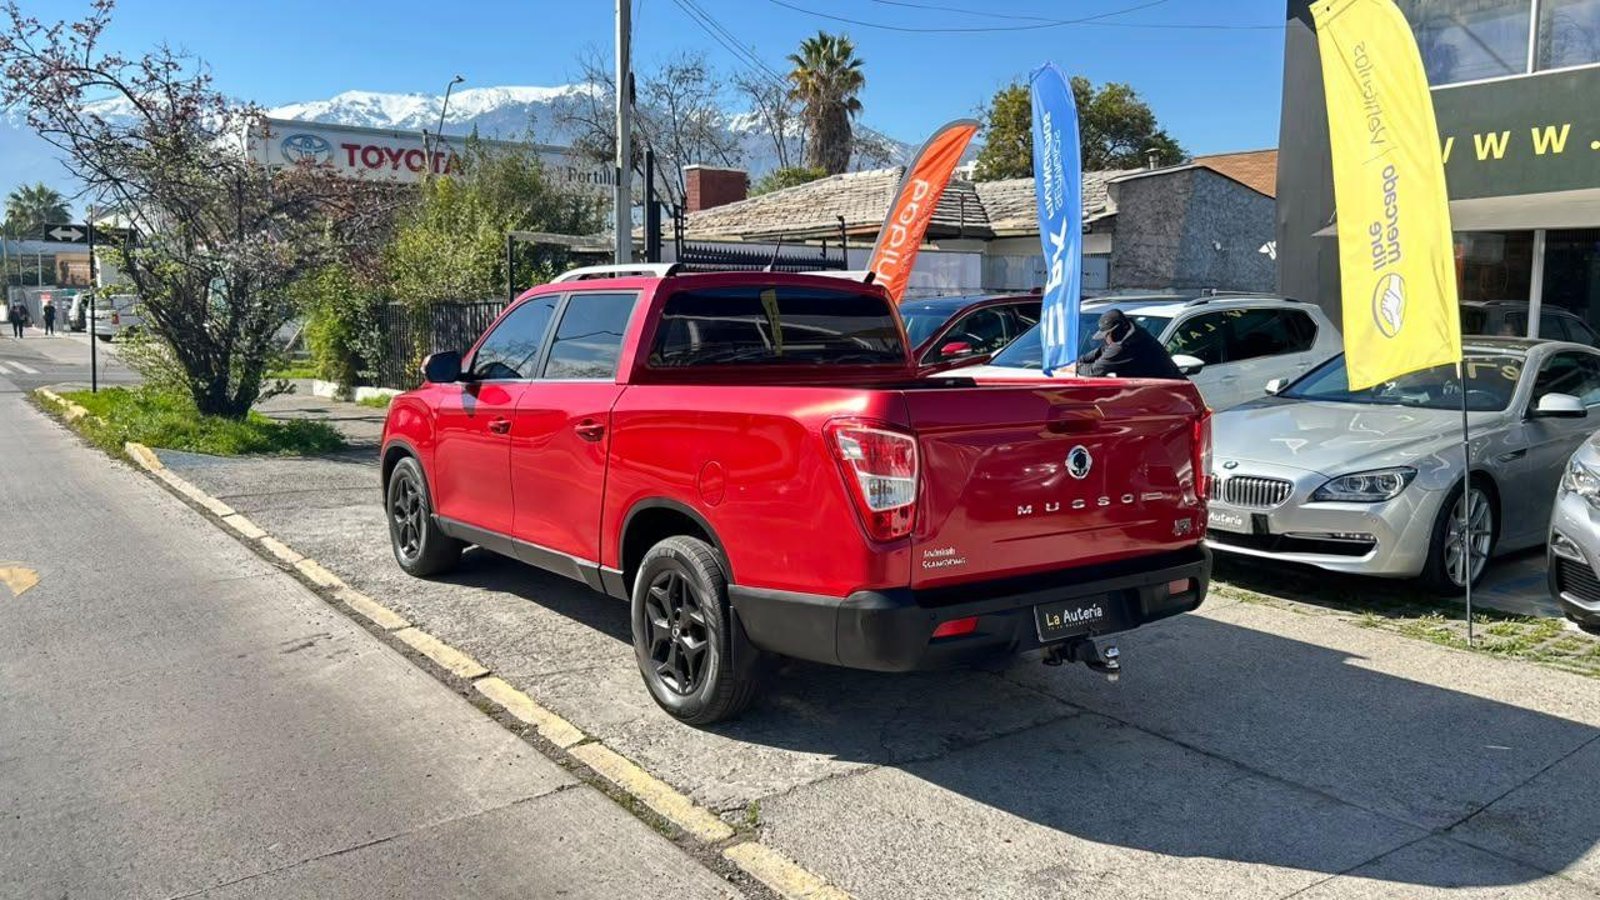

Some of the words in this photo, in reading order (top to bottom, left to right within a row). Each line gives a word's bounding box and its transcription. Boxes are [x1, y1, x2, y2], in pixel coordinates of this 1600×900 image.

[341, 143, 465, 176] TOYOTA
[1017, 493, 1134, 515] MUSSO
[1045, 613, 1061, 626] La
[1063, 603, 1102, 623] Autería
